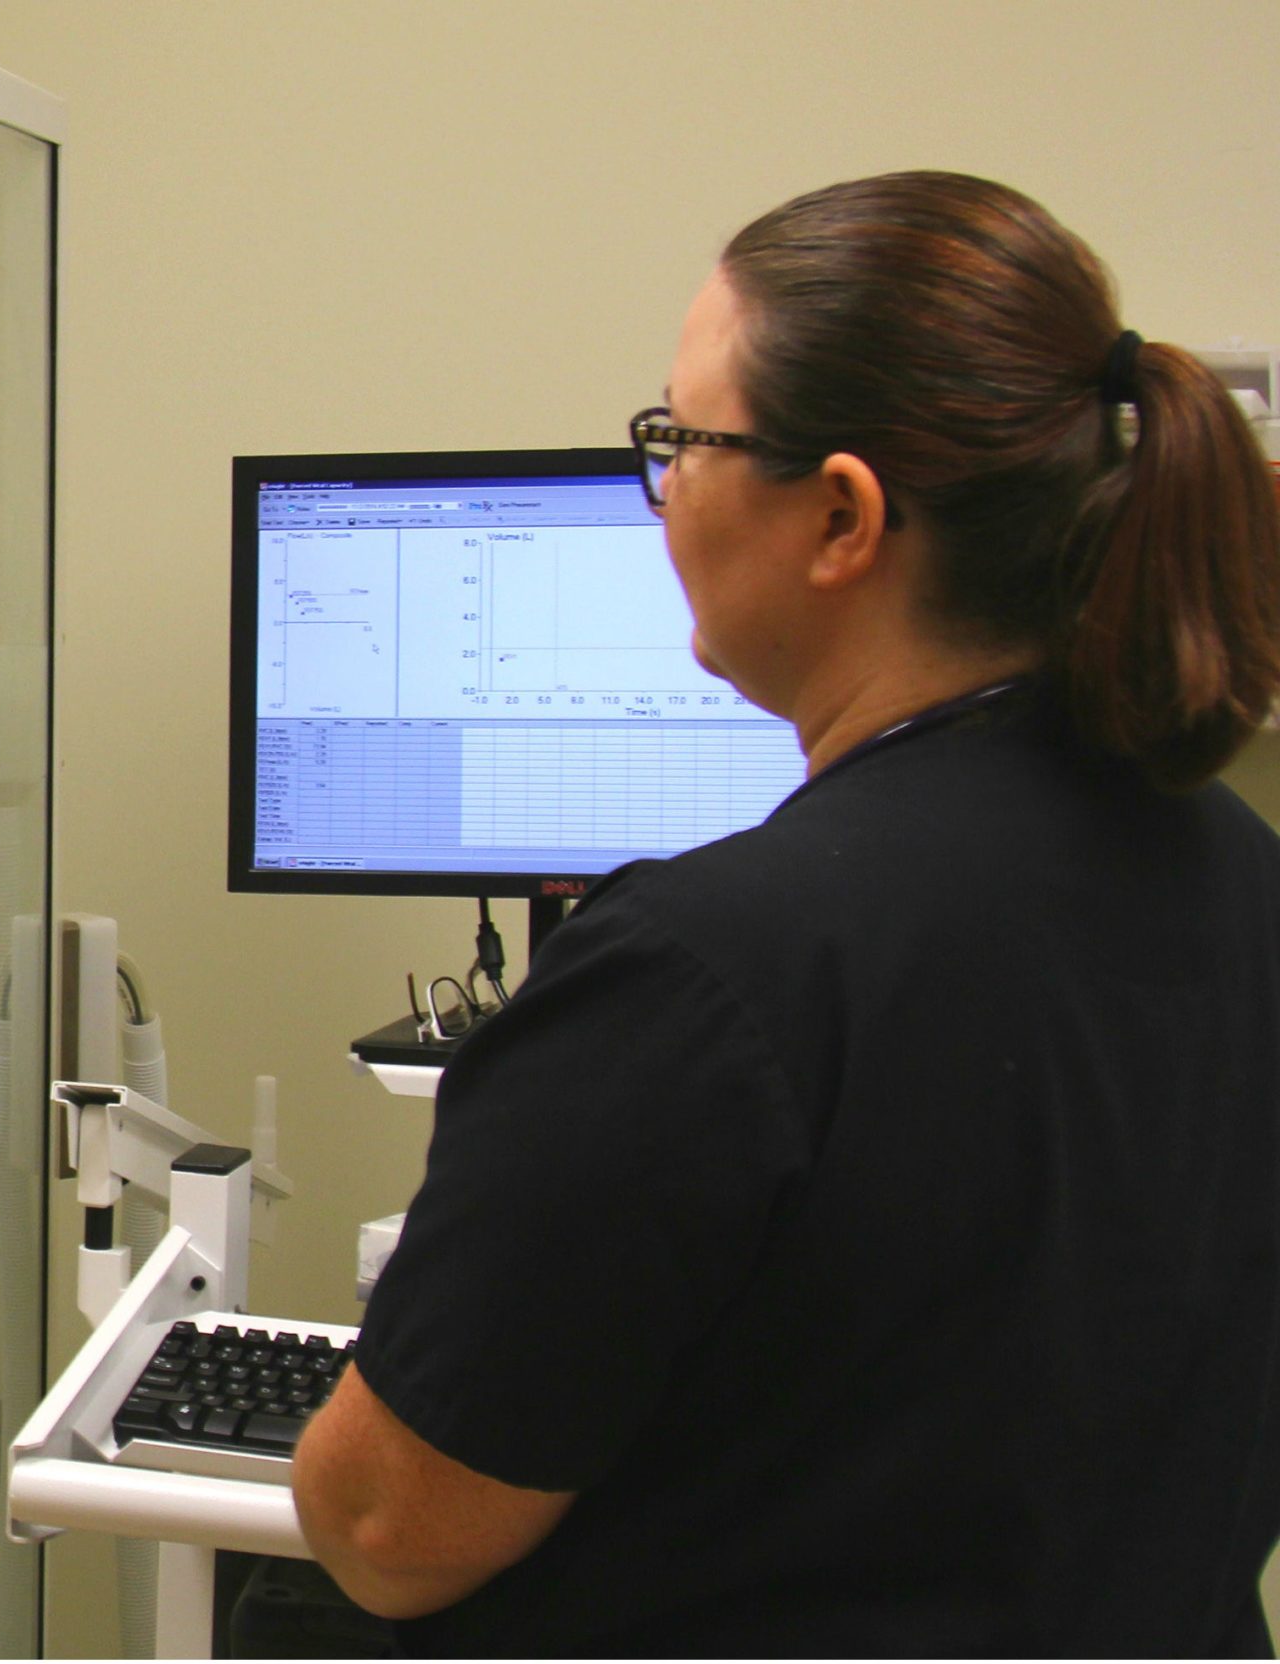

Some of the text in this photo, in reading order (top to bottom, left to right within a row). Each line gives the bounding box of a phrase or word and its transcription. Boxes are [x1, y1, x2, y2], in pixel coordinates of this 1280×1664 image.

[487, 532, 534, 542] Volume (L)
[462, 613, 477, 621] 4.0
[462, 650, 476, 658] 2.0
[462, 687, 476, 695] 0.0
[505, 696, 519, 704] 2.0
[537, 696, 552, 704] 5.0
[602, 696, 620, 704] 11.0
[634, 696, 652, 704] 14.0
[668, 696, 686, 704] 17.0
[701, 696, 720, 704] 20.0
[625, 708, 647, 716] Time
